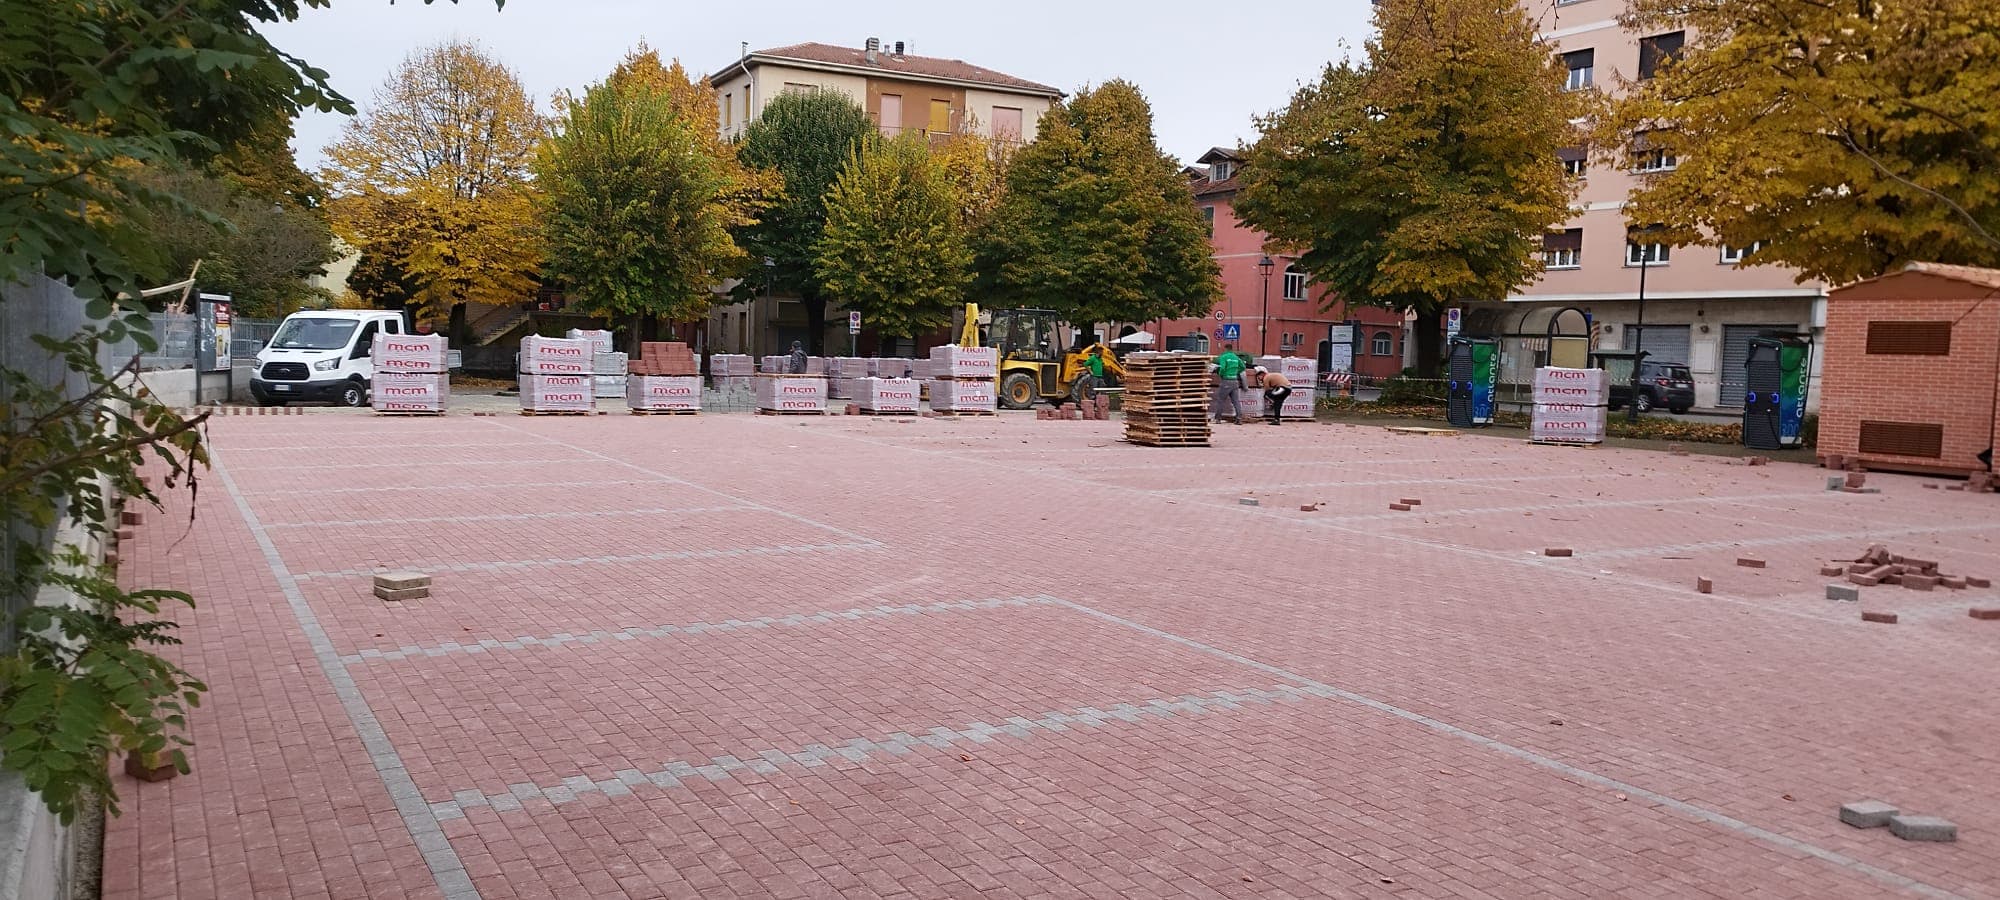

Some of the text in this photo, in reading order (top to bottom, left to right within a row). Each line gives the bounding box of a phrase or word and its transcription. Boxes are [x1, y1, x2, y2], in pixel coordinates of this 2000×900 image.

[388, 343, 430, 351] mcm
[540, 347, 581, 355] mcm
[386, 360, 431, 368] mcm
[540, 363, 581, 371] mcm
[1487, 353, 1496, 403] atlante
[1549, 370, 1585, 379] mcm
[547, 377, 579, 385] mcm
[654, 387, 690, 395] mcm
[1545, 387, 1587, 395] mcm
[1796, 357, 1807, 418] atlante
[545, 393, 583, 401] mcm
[1545, 421, 1586, 429] mcm
